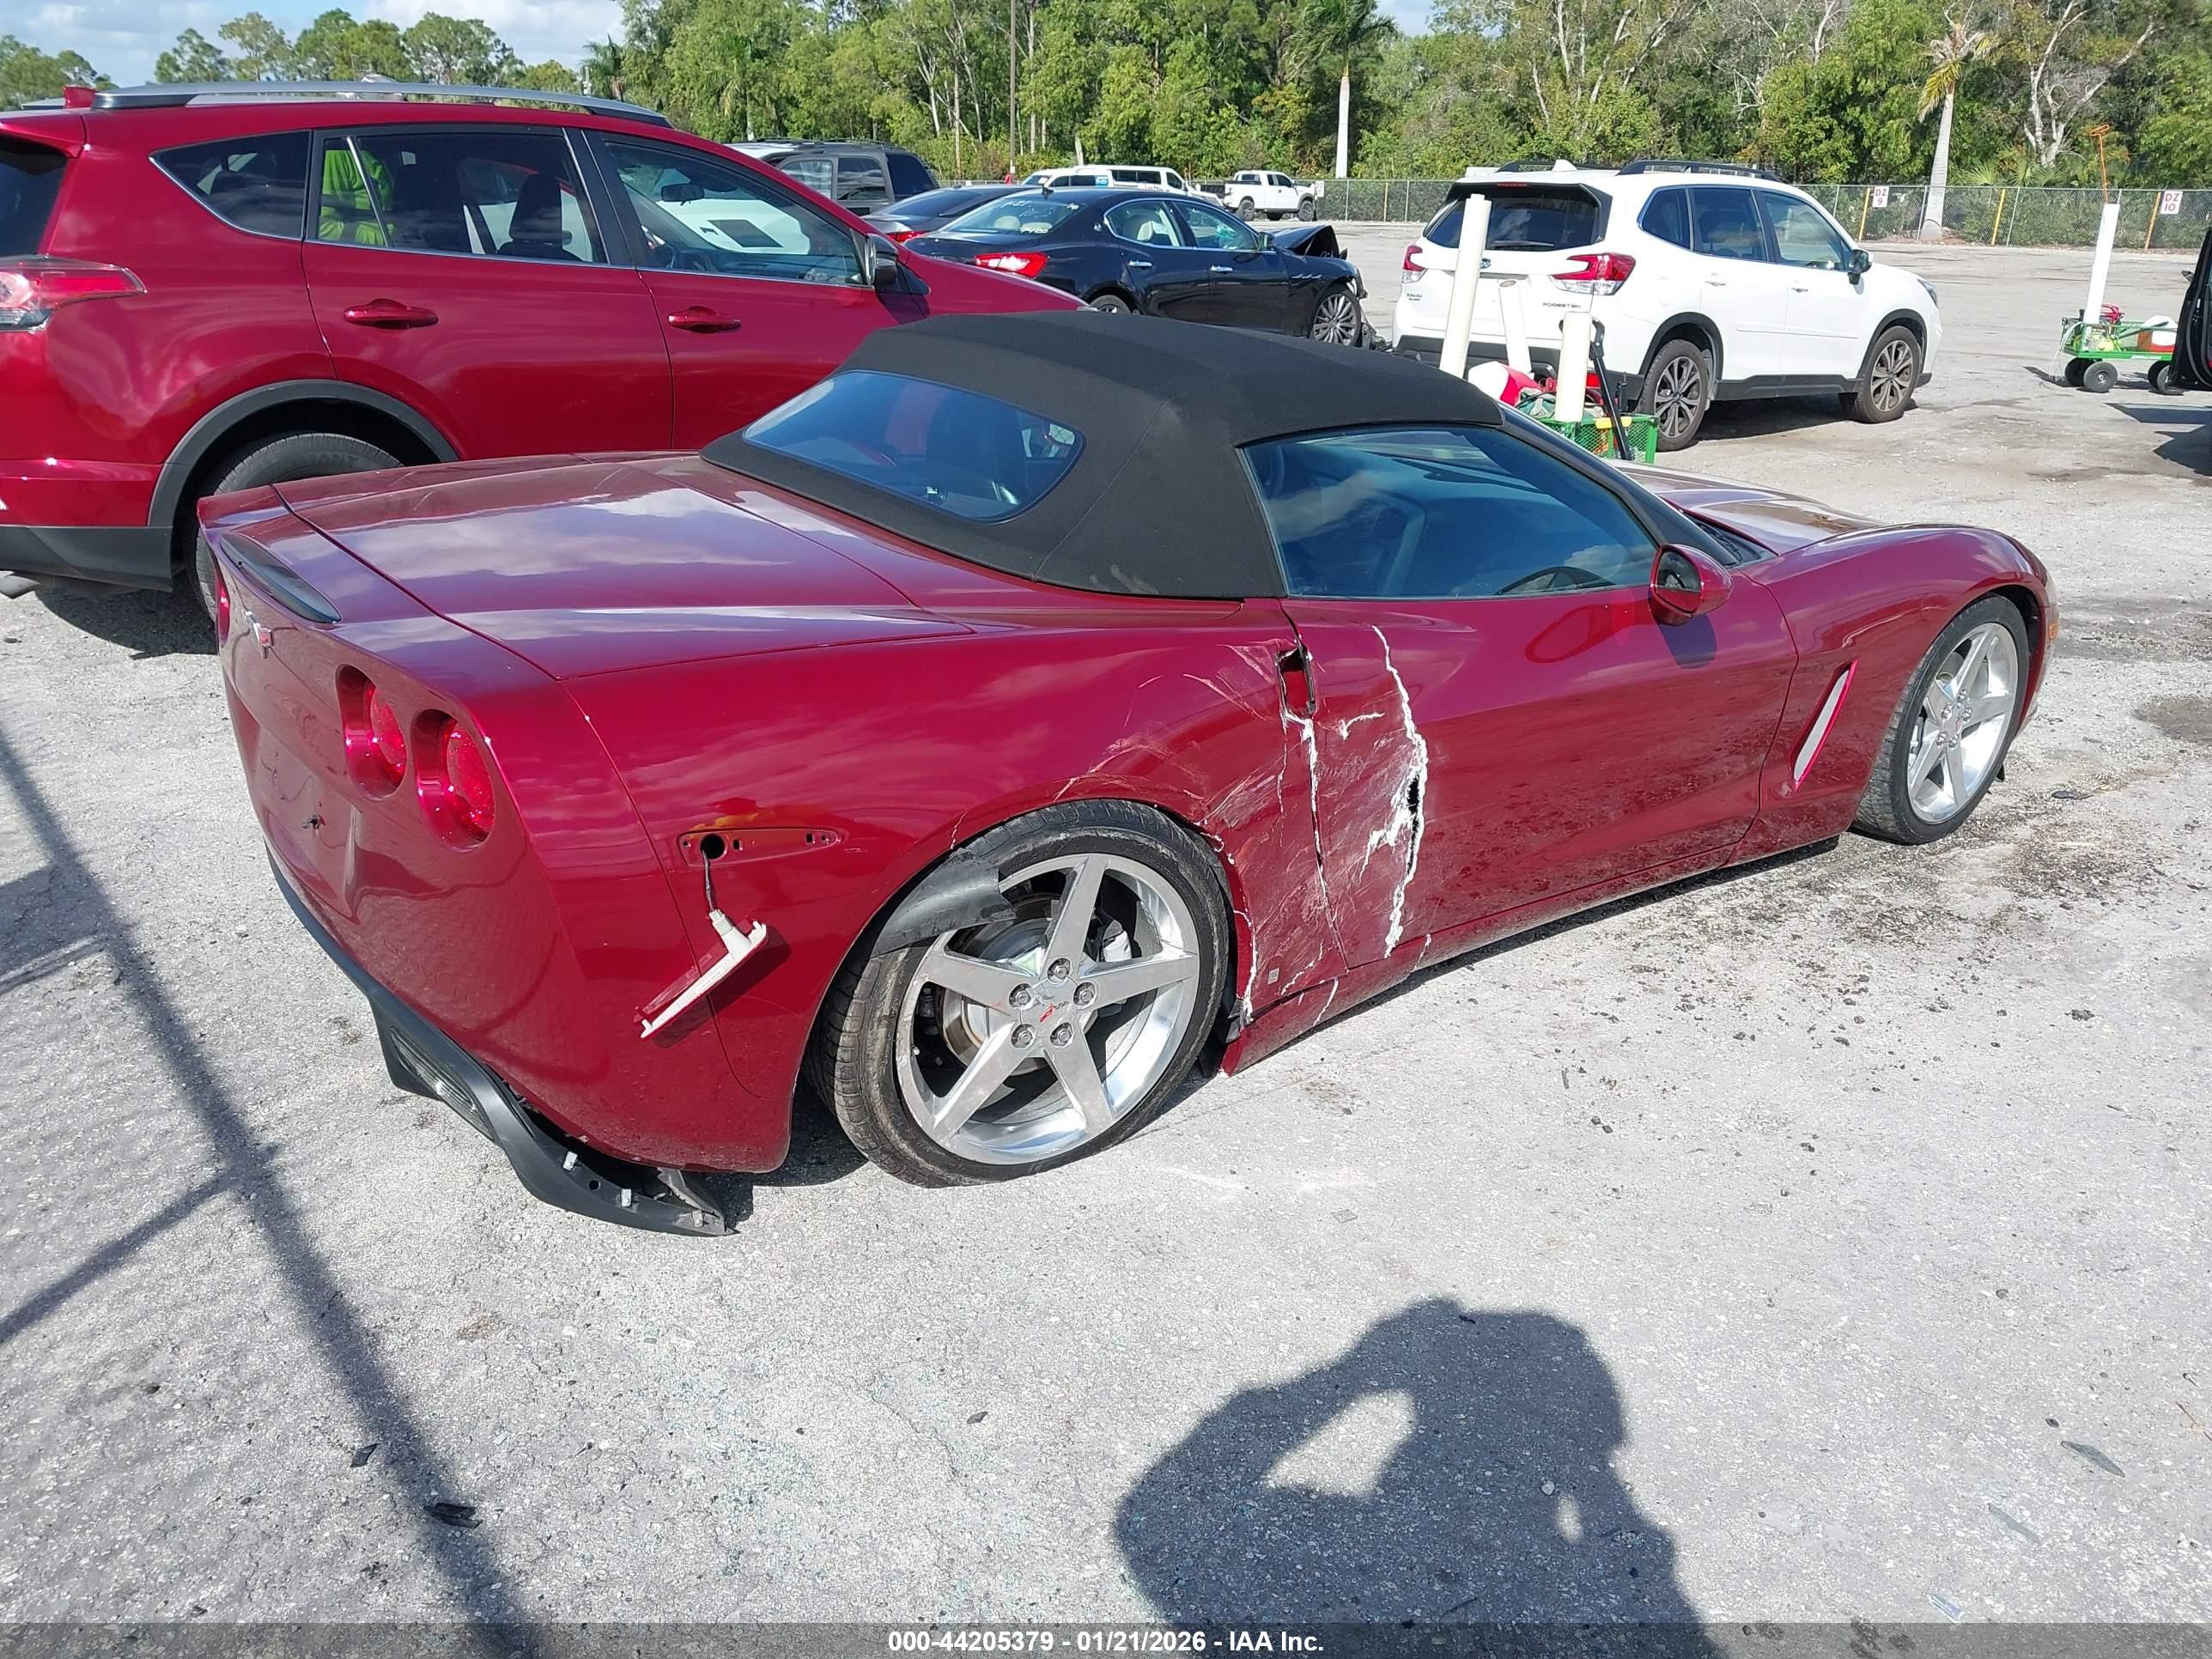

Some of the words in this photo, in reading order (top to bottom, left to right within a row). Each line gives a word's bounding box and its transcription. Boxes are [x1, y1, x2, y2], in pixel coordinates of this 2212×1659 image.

[1875, 188, 1887, 197] DZ
[2165, 192, 2180, 202] DZ
[2164, 203, 2176, 212] 10
